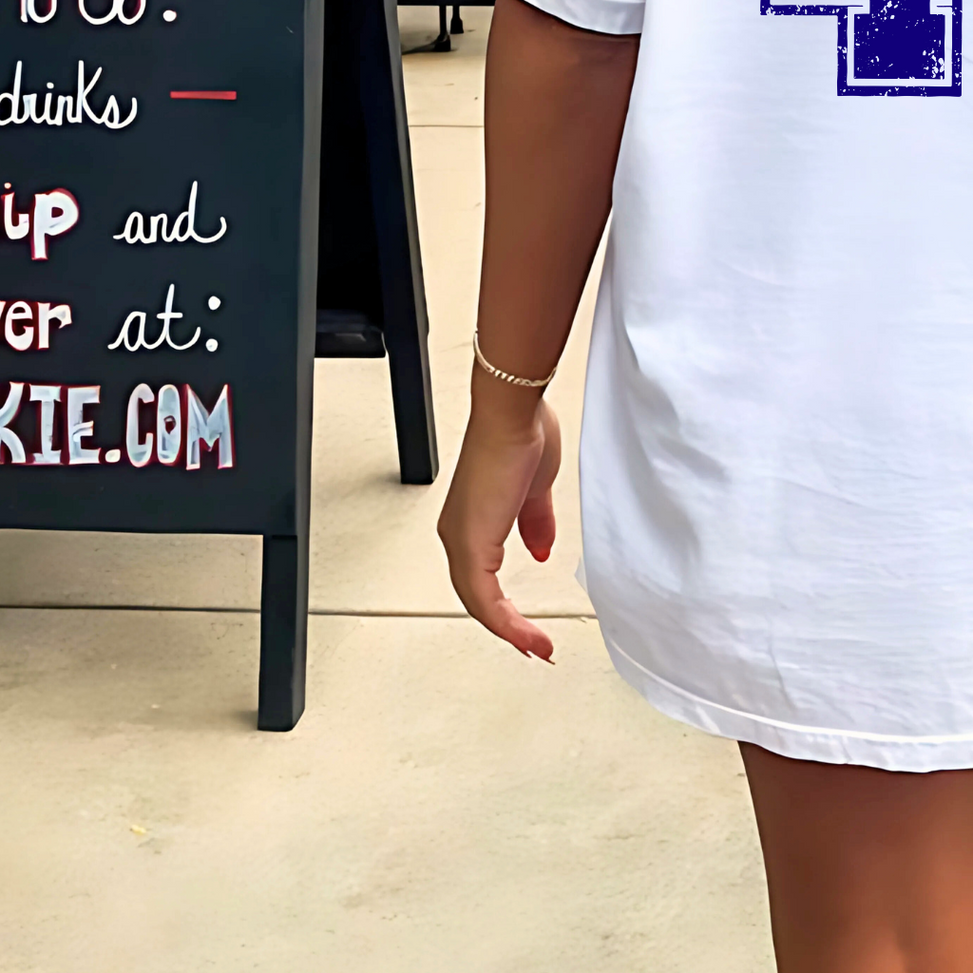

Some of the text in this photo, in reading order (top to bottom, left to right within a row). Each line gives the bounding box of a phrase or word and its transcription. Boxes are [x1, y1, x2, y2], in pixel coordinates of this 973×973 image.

[1, 181, 227, 260] ip and
[0, 300, 73, 351] er
